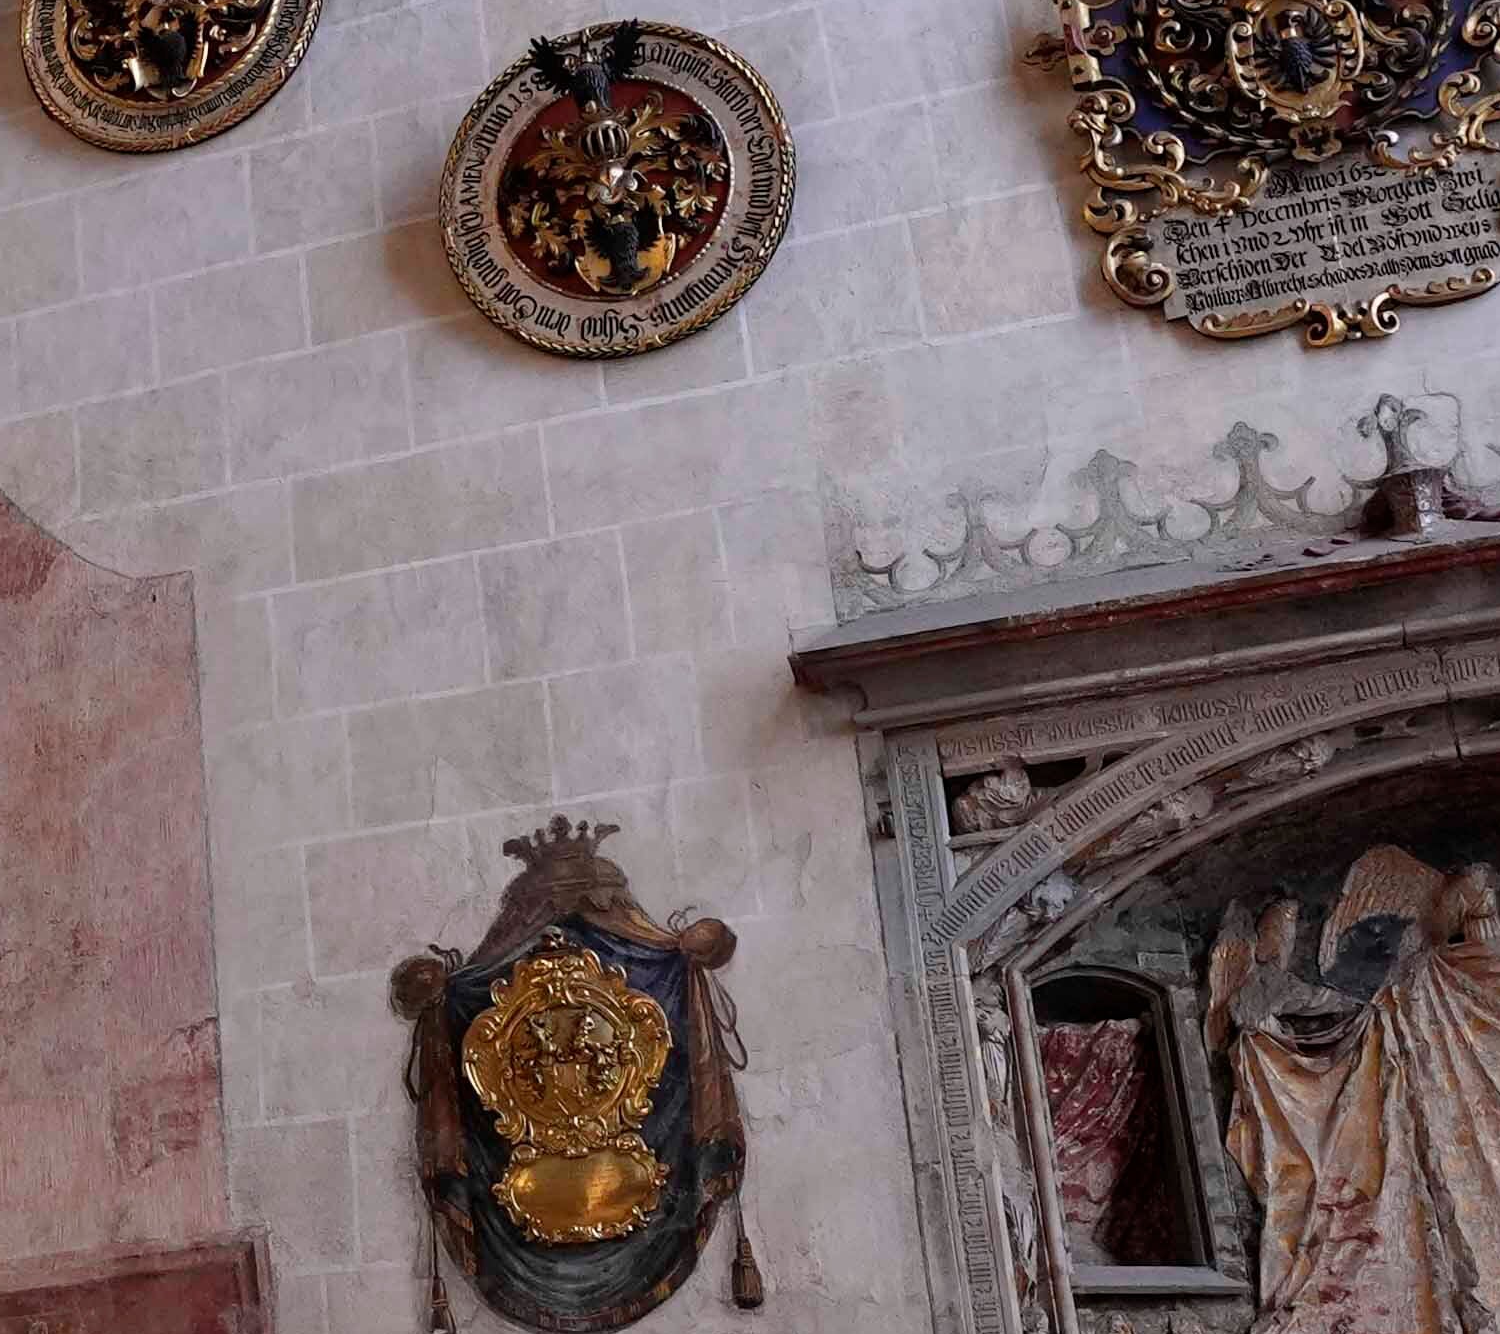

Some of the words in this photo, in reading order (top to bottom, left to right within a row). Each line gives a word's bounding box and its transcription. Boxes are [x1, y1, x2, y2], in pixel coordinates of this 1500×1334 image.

[1238, 195, 1341, 227] Decembris
[1349, 212, 1368, 232] in
[1381, 201, 1432, 226] Gott
[495, 283, 537, 318] Gott
[535, 306, 571, 335] dem
